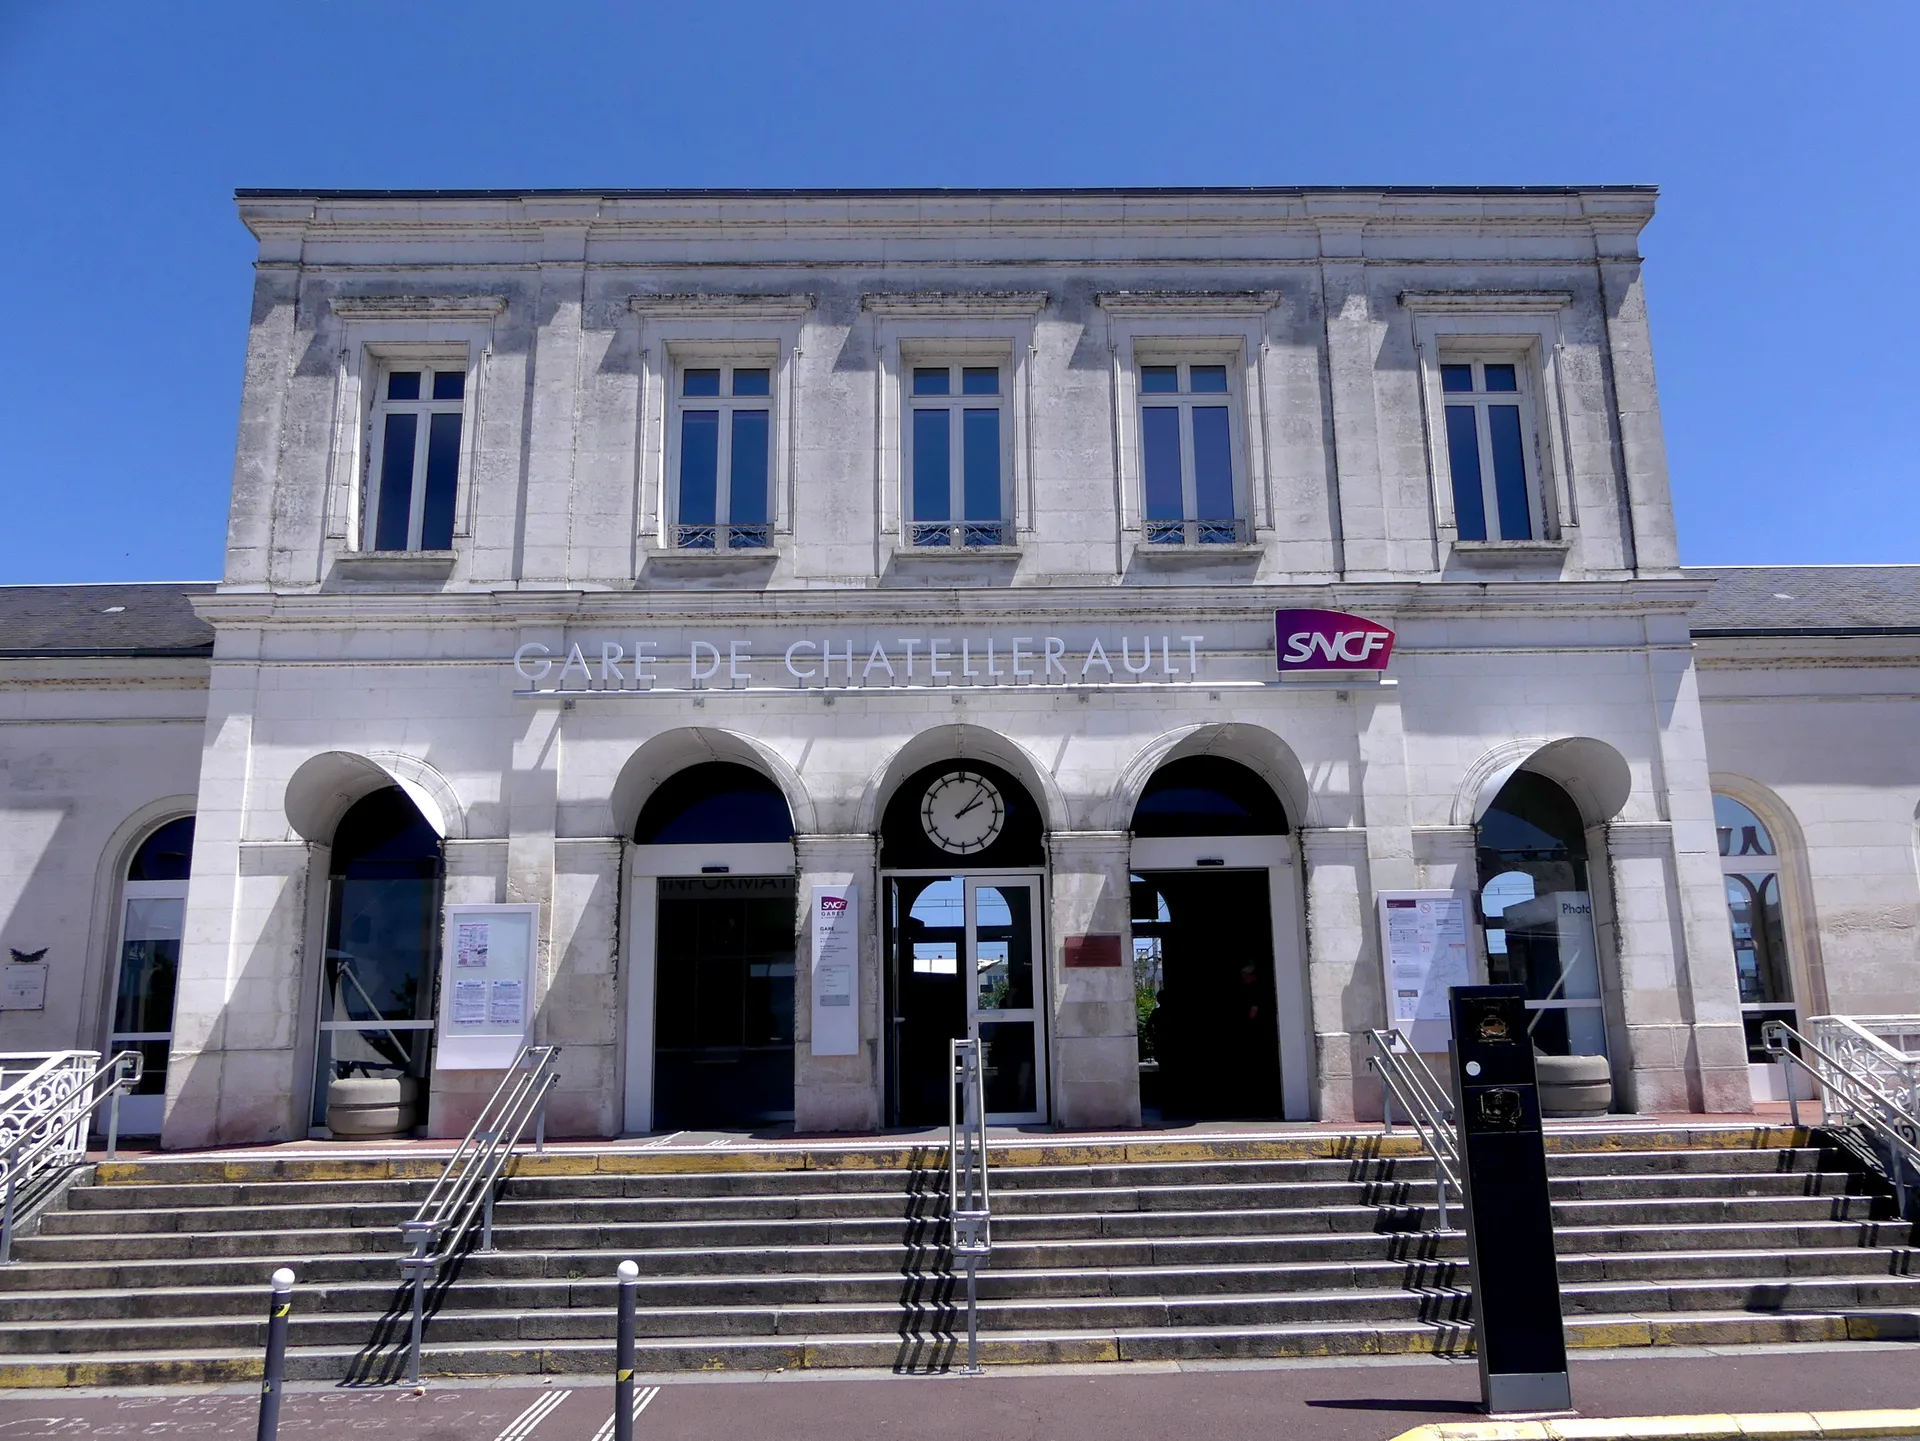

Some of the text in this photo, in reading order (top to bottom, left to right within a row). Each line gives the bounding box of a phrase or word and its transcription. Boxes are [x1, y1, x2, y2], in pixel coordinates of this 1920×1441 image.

[513, 635, 1204, 681] GARE DE CHATELLERAULT
[1283, 631, 1389, 663] SNCF
[822, 901, 846, 910] SNCF
